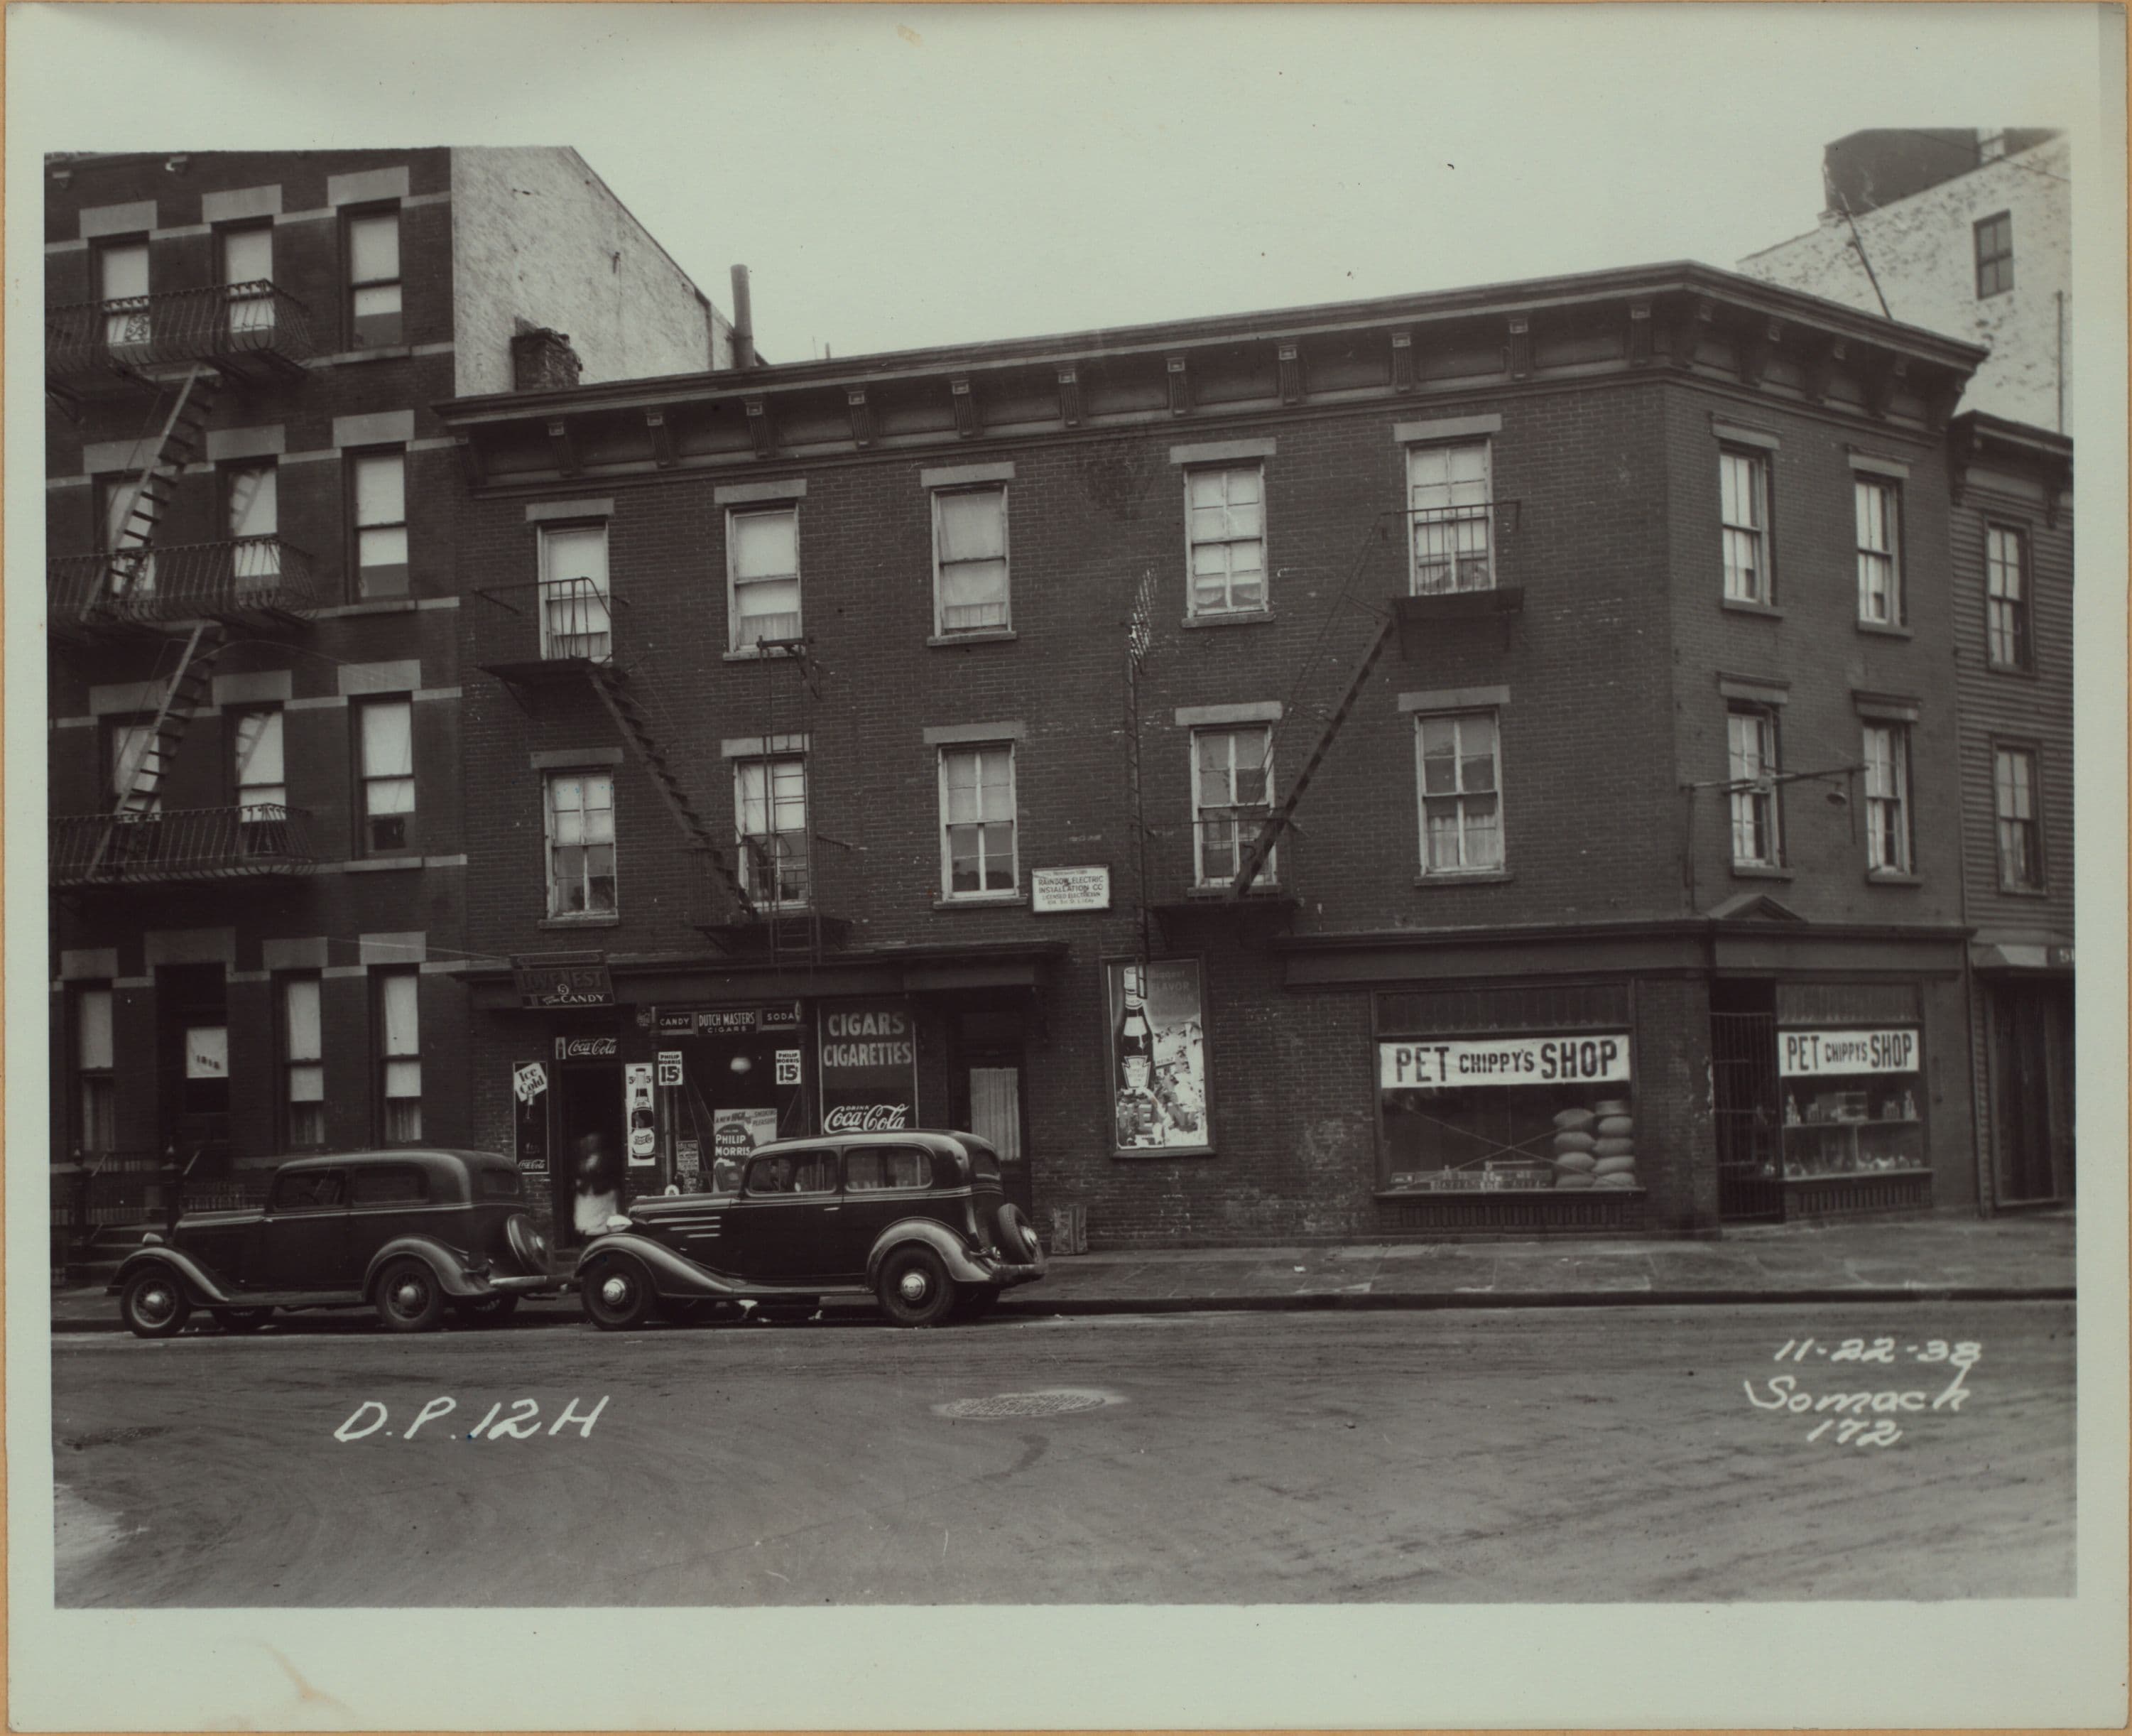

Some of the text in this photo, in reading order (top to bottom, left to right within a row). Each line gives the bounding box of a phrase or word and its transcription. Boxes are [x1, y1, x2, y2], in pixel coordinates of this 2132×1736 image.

[1072, 875, 1103, 884] ELECTRIC
[560, 994, 604, 1003] CANDY
[659, 1017, 690, 1026] CANDY
[699, 1011, 755, 1027] DUTCH MASTERS
[767, 1012, 794, 1021] SODA
[828, 1012, 905, 1036] CIGARS
[823, 1042, 913, 1067] CIGARETTES
[1787, 1035, 1820, 1071] PET
[1870, 1034, 1913, 1068] SHOP
[1396, 1039, 1618, 1083] PET CHIPPY'S SHOP
[518, 1068, 538, 1083] Ice
[520, 1075, 545, 1093] Cold
[716, 1134, 746, 1144] PHILIP
[715, 1146, 751, 1156] MORRIS
